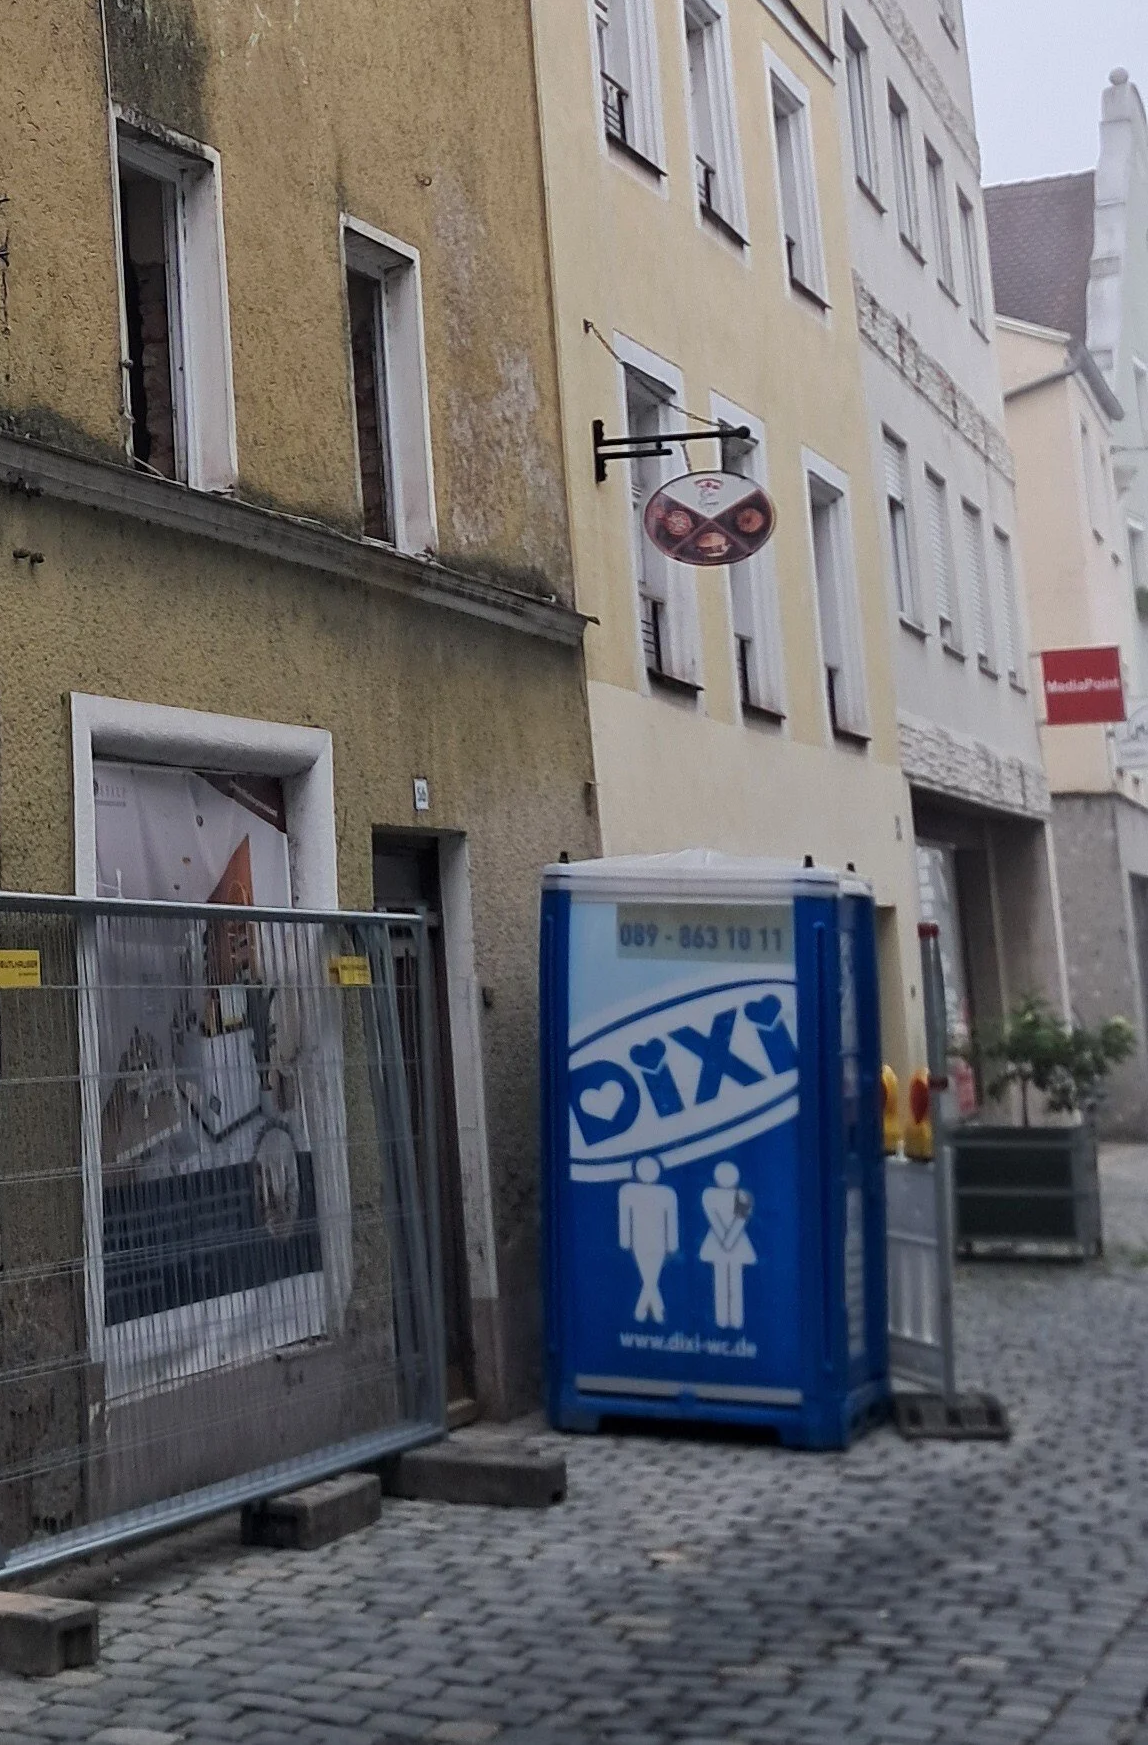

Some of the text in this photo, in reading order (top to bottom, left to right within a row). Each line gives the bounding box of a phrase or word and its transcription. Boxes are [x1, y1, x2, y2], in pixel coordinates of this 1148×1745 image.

[1045, 677, 1120, 693] MediaPoint
[619, 923, 659, 947] 089
[679, 924, 718, 950] 863
[726, 925, 751, 951] 10
[759, 926, 781, 951] 11
[619, 1332, 757, 1359] www.dixi-wc.de
